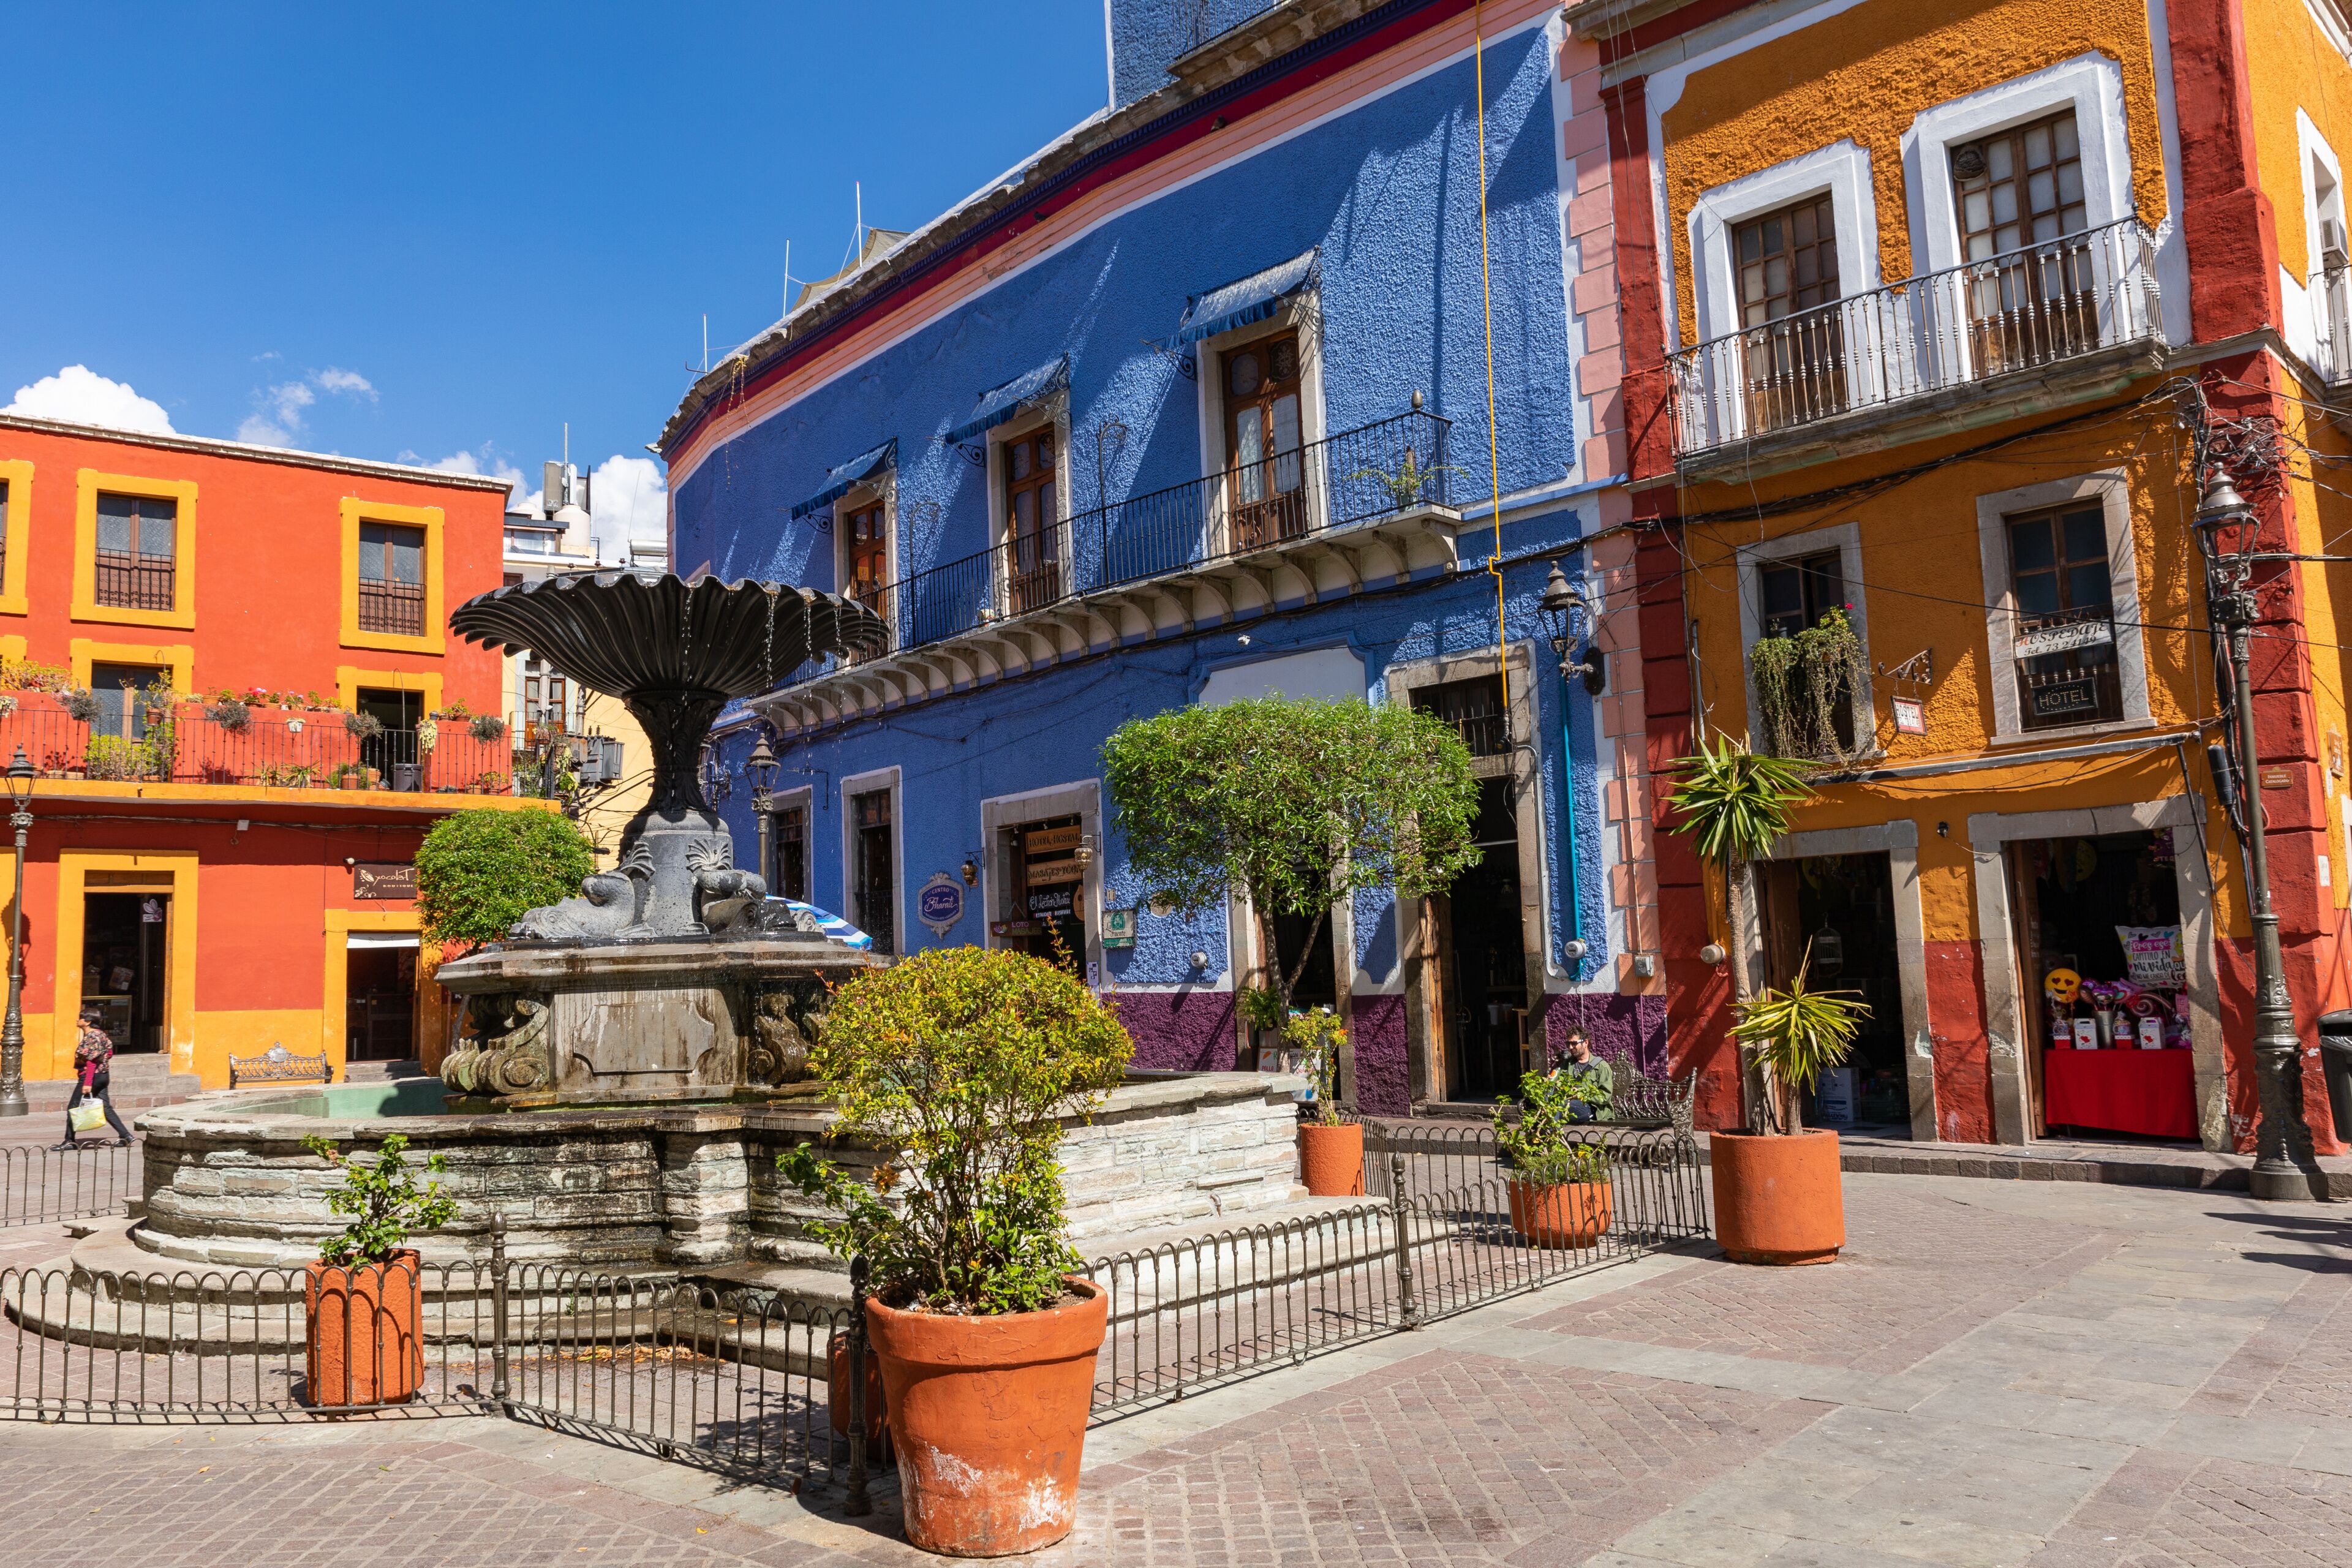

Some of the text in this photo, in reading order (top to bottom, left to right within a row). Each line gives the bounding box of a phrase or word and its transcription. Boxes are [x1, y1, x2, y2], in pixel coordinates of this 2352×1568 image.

[2016, 621, 2108, 647] HOSPEDAJE
[2038, 688, 2089, 707] HOTEL
[1895, 704, 1918, 719] HOSTEL
[1029, 836, 1050, 848] HOTEL
[1028, 867, 1060, 881] MASAJES
[924, 895, 958, 912] Bharati
[2133, 940, 2169, 951] eres ese
[2162, 950, 2171, 959] EN
